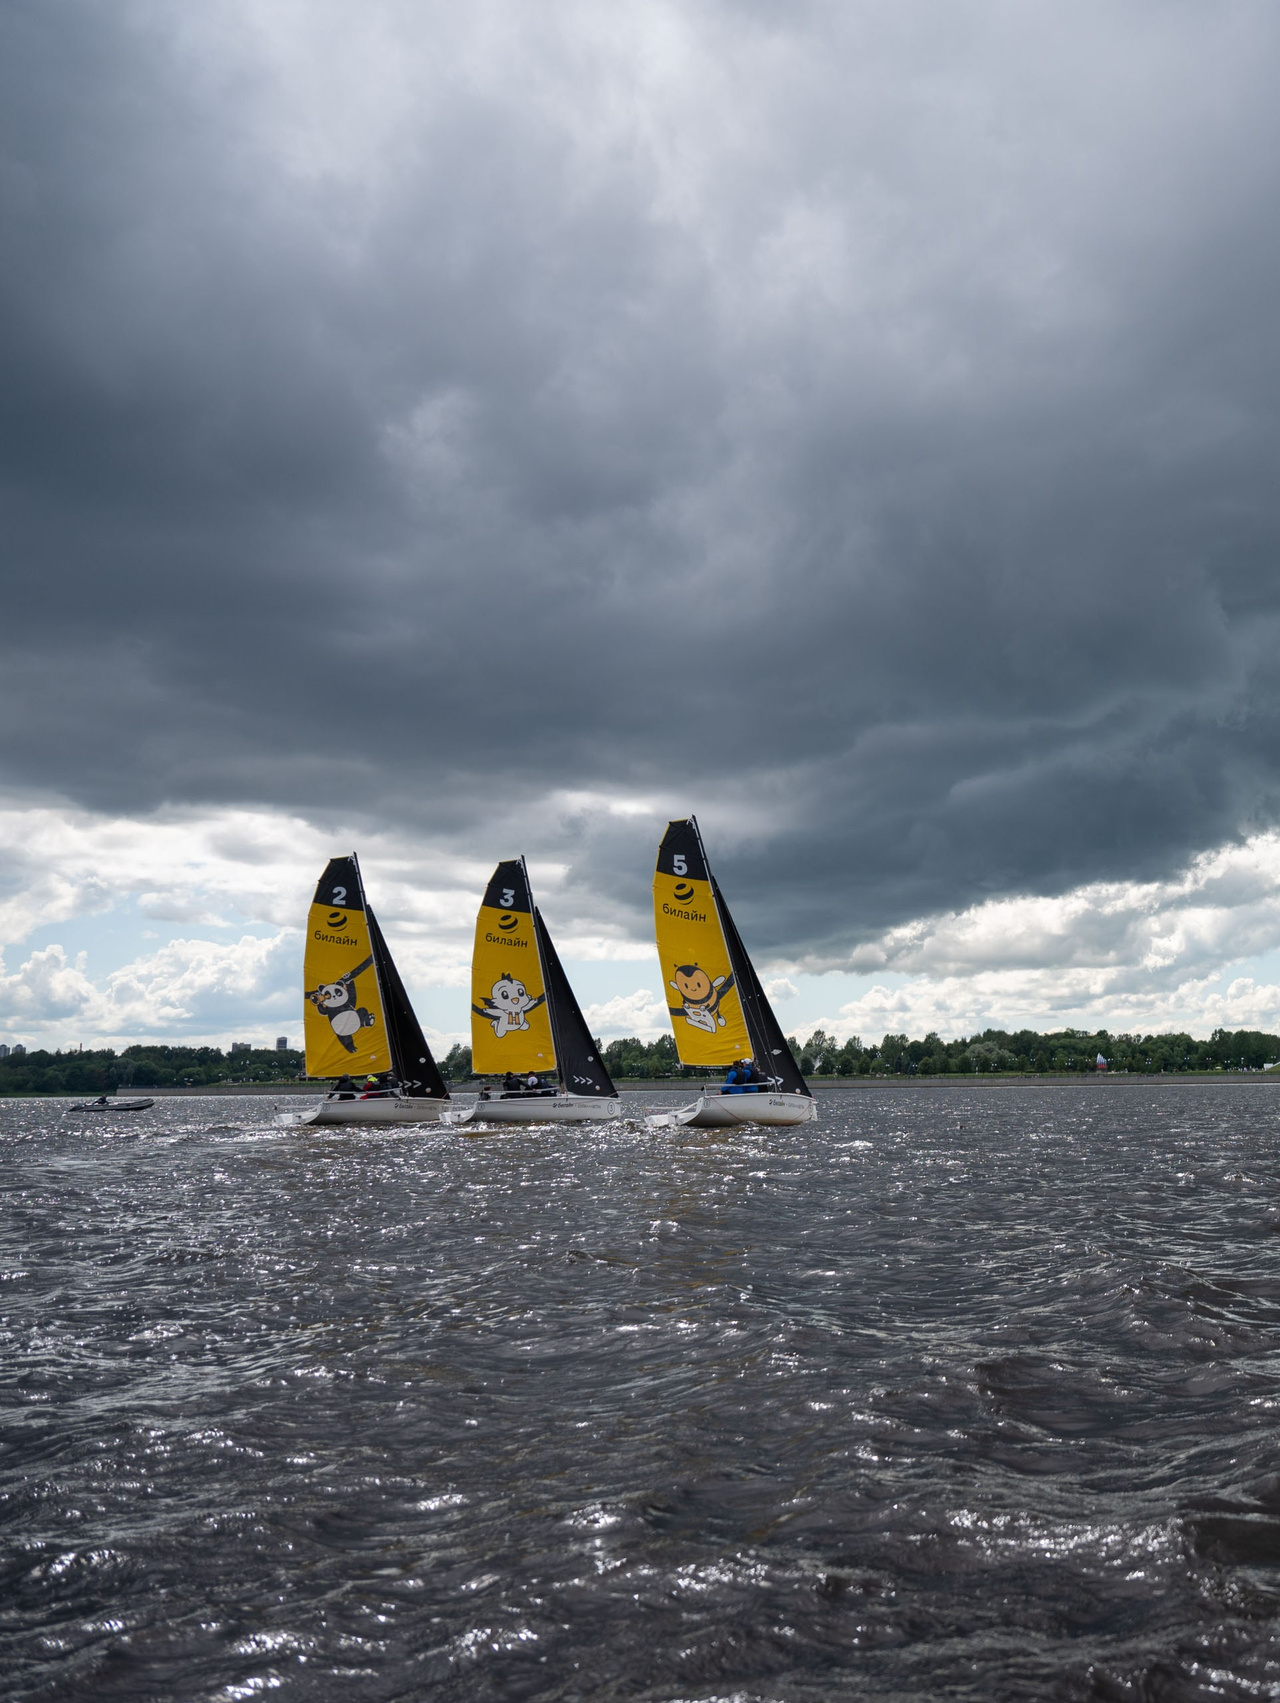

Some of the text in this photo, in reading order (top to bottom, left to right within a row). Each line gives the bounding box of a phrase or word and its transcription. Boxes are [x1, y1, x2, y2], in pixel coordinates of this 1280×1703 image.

[673, 854, 688, 876] 5
[332, 886, 347, 905] 2
[500, 888, 515, 907] 3
[662, 903, 707, 923] билайн
[314, 930, 358, 947] билайн
[485, 932, 528, 949] билайн
